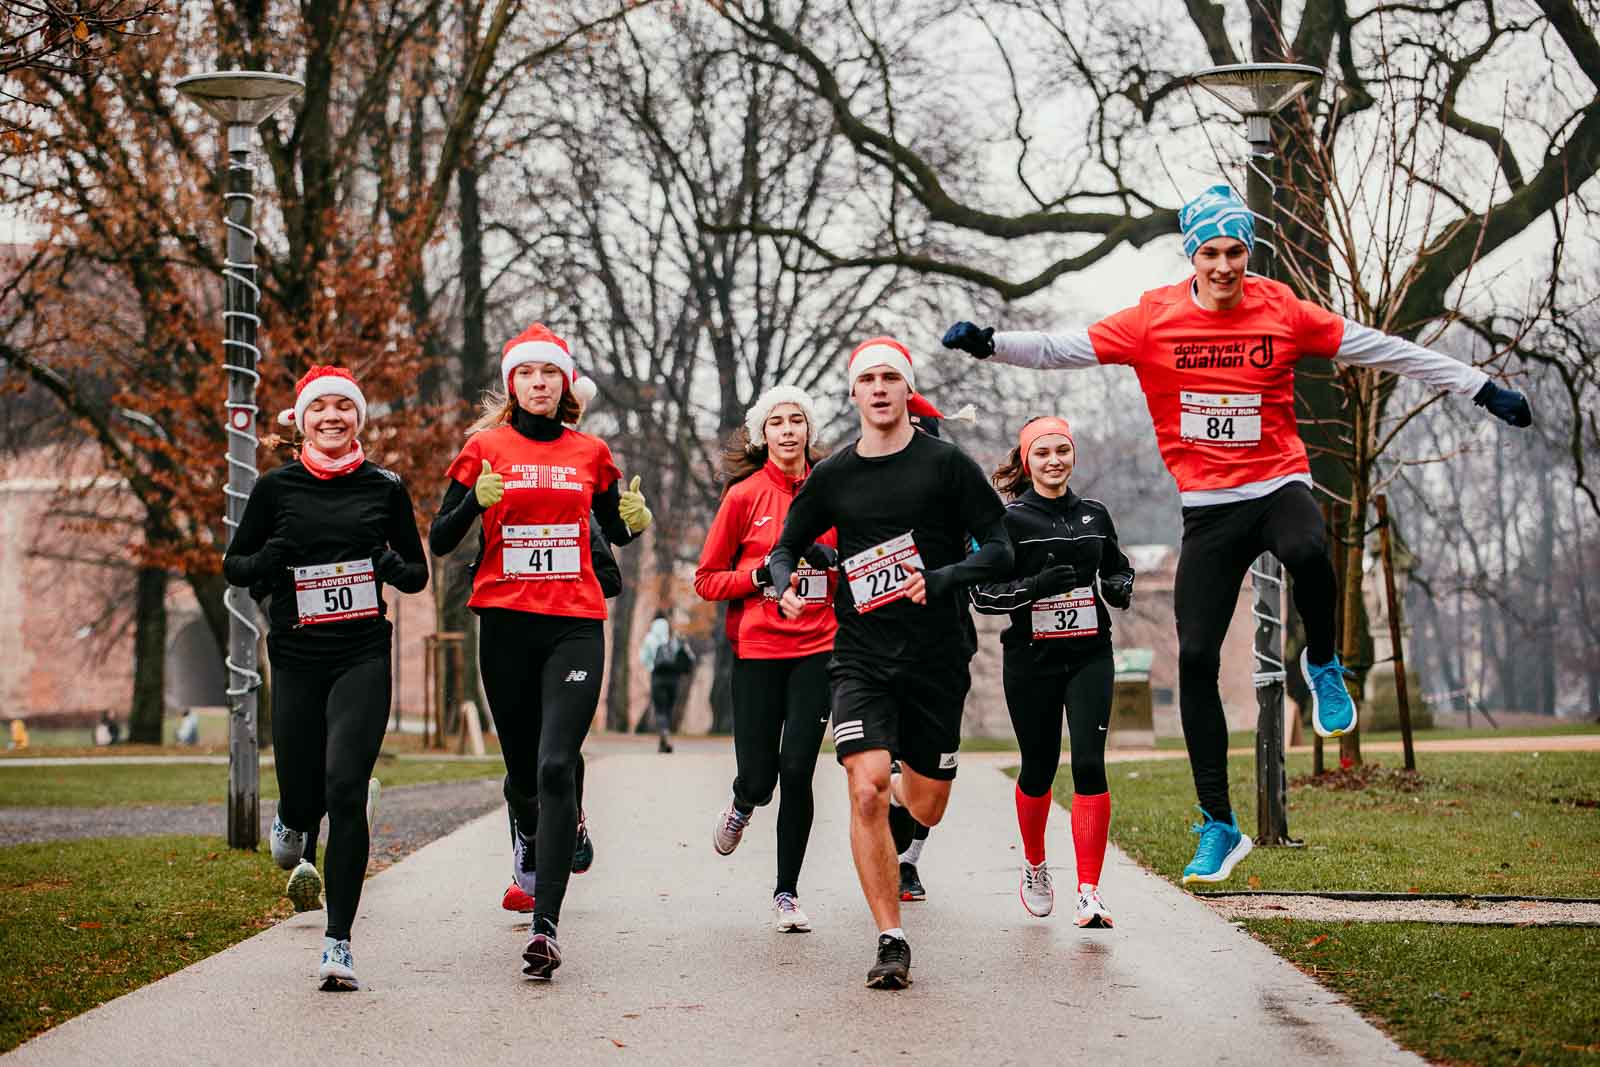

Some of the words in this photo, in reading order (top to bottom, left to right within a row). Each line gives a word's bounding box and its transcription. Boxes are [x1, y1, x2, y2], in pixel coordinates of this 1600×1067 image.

[1206, 417, 1235, 440] 84
[527, 539, 557, 547] ADVENT
[559, 539, 574, 547] RUN
[528, 548, 553, 572] 41
[867, 557, 895, 573] ADVENT
[895, 549, 912, 561] RUN
[322, 576, 353, 588] ADVENT
[354, 574, 369, 584] RUN
[866, 563, 907, 598] 224
[323, 586, 353, 613] 50
[1053, 601, 1078, 609] ADVENT
[1054, 609, 1079, 631] 32
